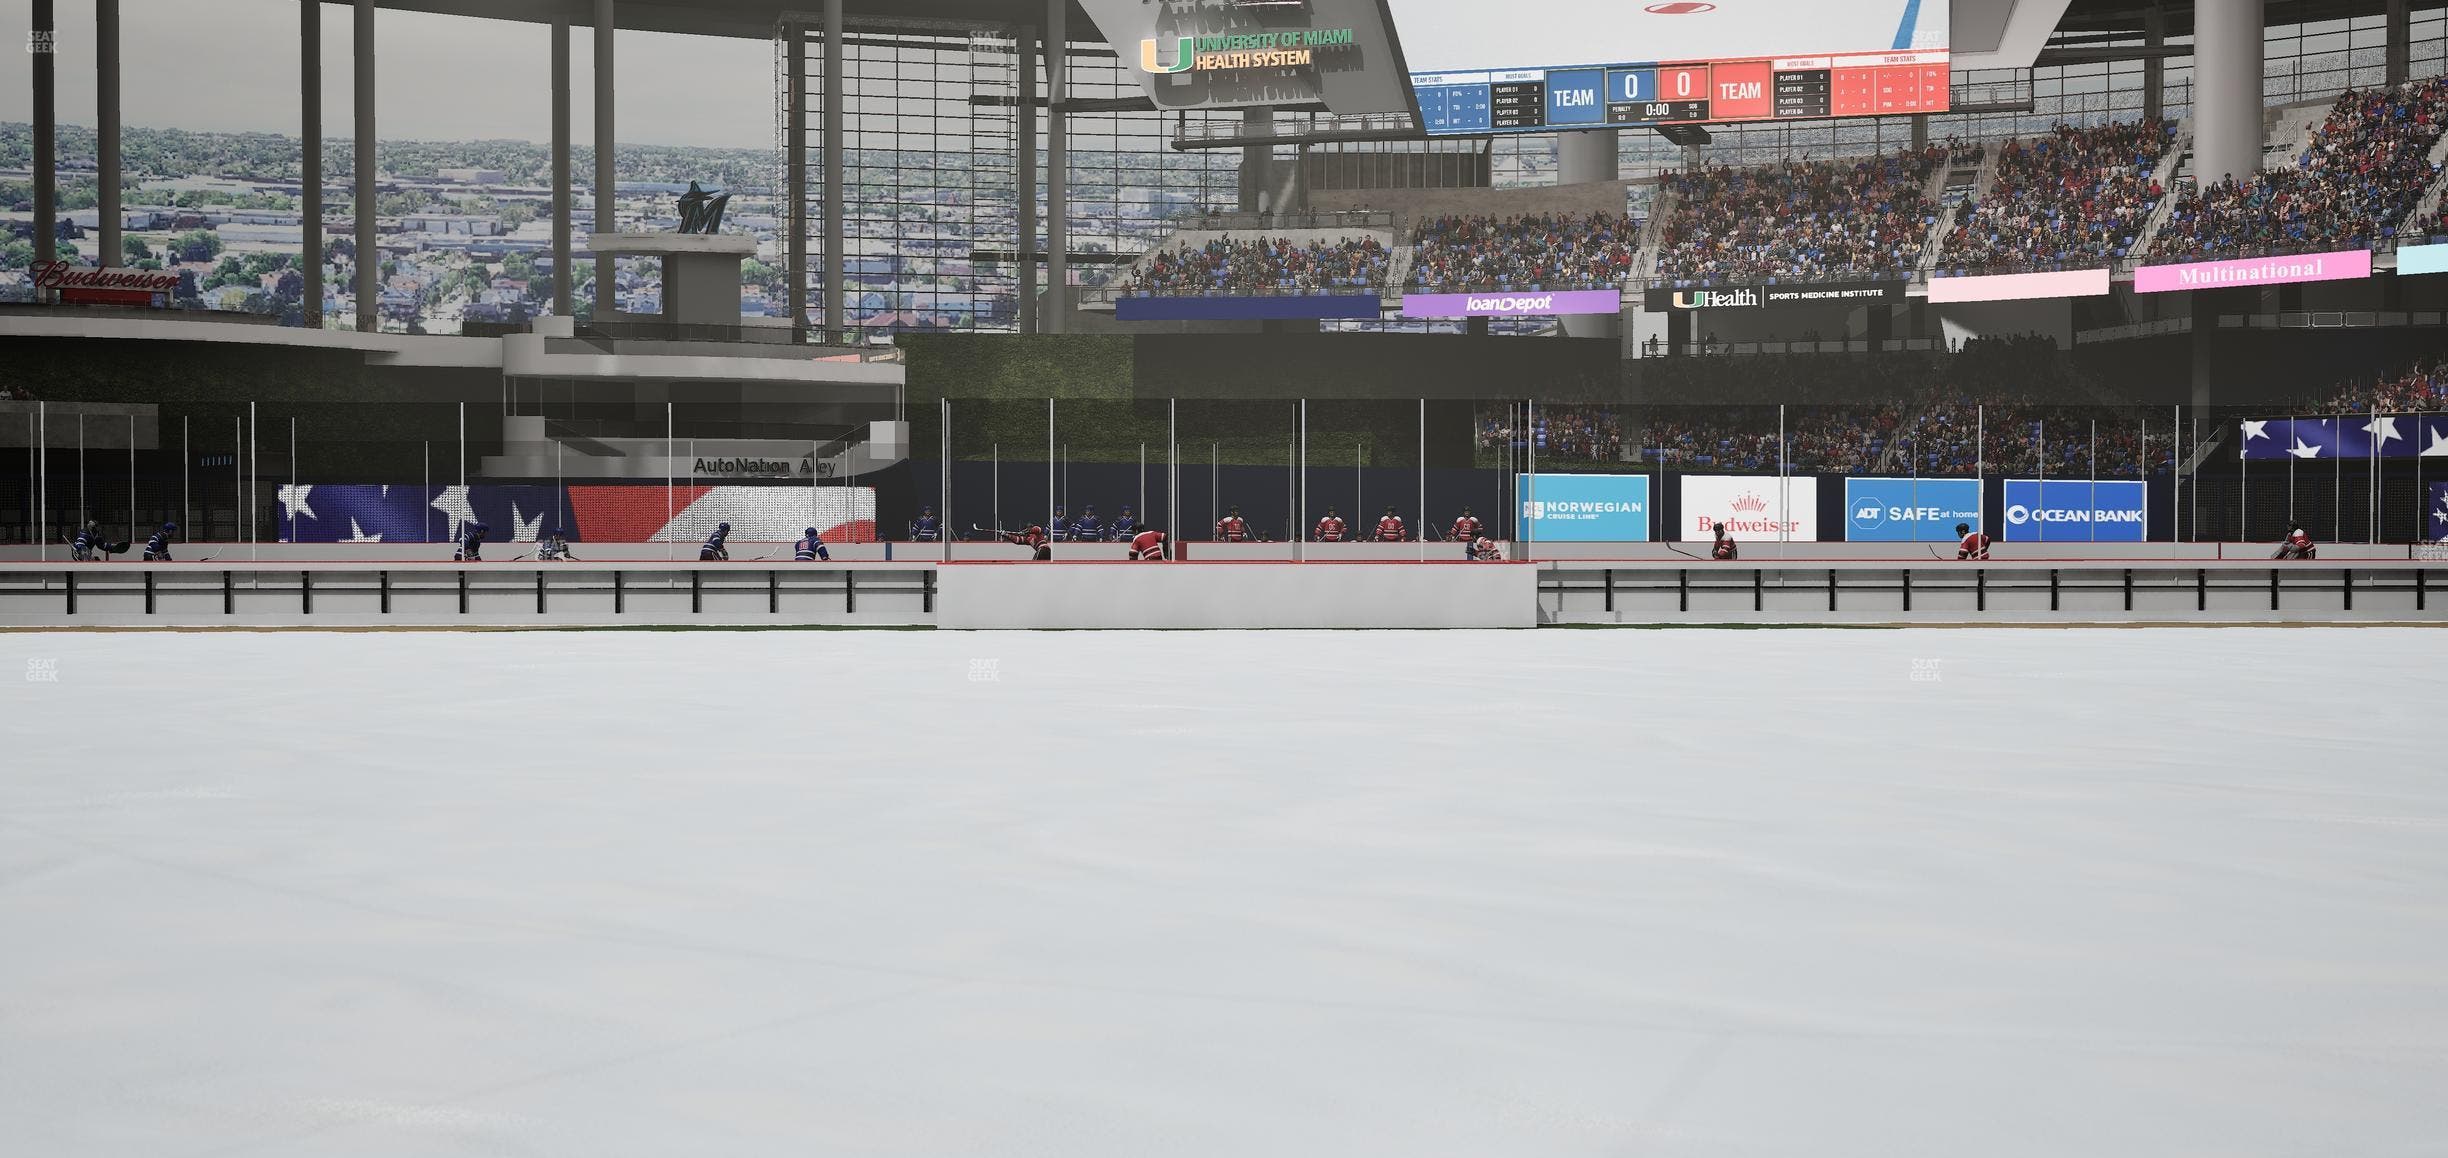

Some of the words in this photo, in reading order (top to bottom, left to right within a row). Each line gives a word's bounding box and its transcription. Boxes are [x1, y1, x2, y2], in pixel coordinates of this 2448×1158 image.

[1195, 33, 1279, 52] UNIVERSITY
[1281, 31, 1300, 47] OF
[1303, 28, 1353, 46] MIAMI
[1196, 52, 1249, 71] HEALTH
[1253, 50, 1310, 68] SYSTEM
[1900, 55, 1916, 63] STATS
[1624, 74, 1638, 99] 0
[1677, 72, 1690, 96] 0
[1720, 81, 1761, 101] TEAM
[1554, 88, 1594, 107] TEAM
[1646, 103, 1669, 115] 0:00
[29, 260, 181, 290] Budweiser
[2179, 258, 2323, 285] Multinational
[1769, 292, 1799, 300] SPORTS
[1801, 290, 1839, 299] MEDICINE
[1841, 289, 1883, 298] INSTITUTE
[1466, 295, 1553, 313] loanDepot
[694, 458, 789, 473] AutoNation
[799, 458, 836, 477] Alley
[1546, 501, 1642, 513] NORWEGIAN
[1856, 507, 1880, 519] ADT
[1889, 507, 1940, 521] SAFE
[1952, 510, 1979, 518] home
[2031, 509, 2090, 522] OCEAN
[2094, 509, 2144, 522] BANK
[1697, 516, 1799, 532] Bdweiser
